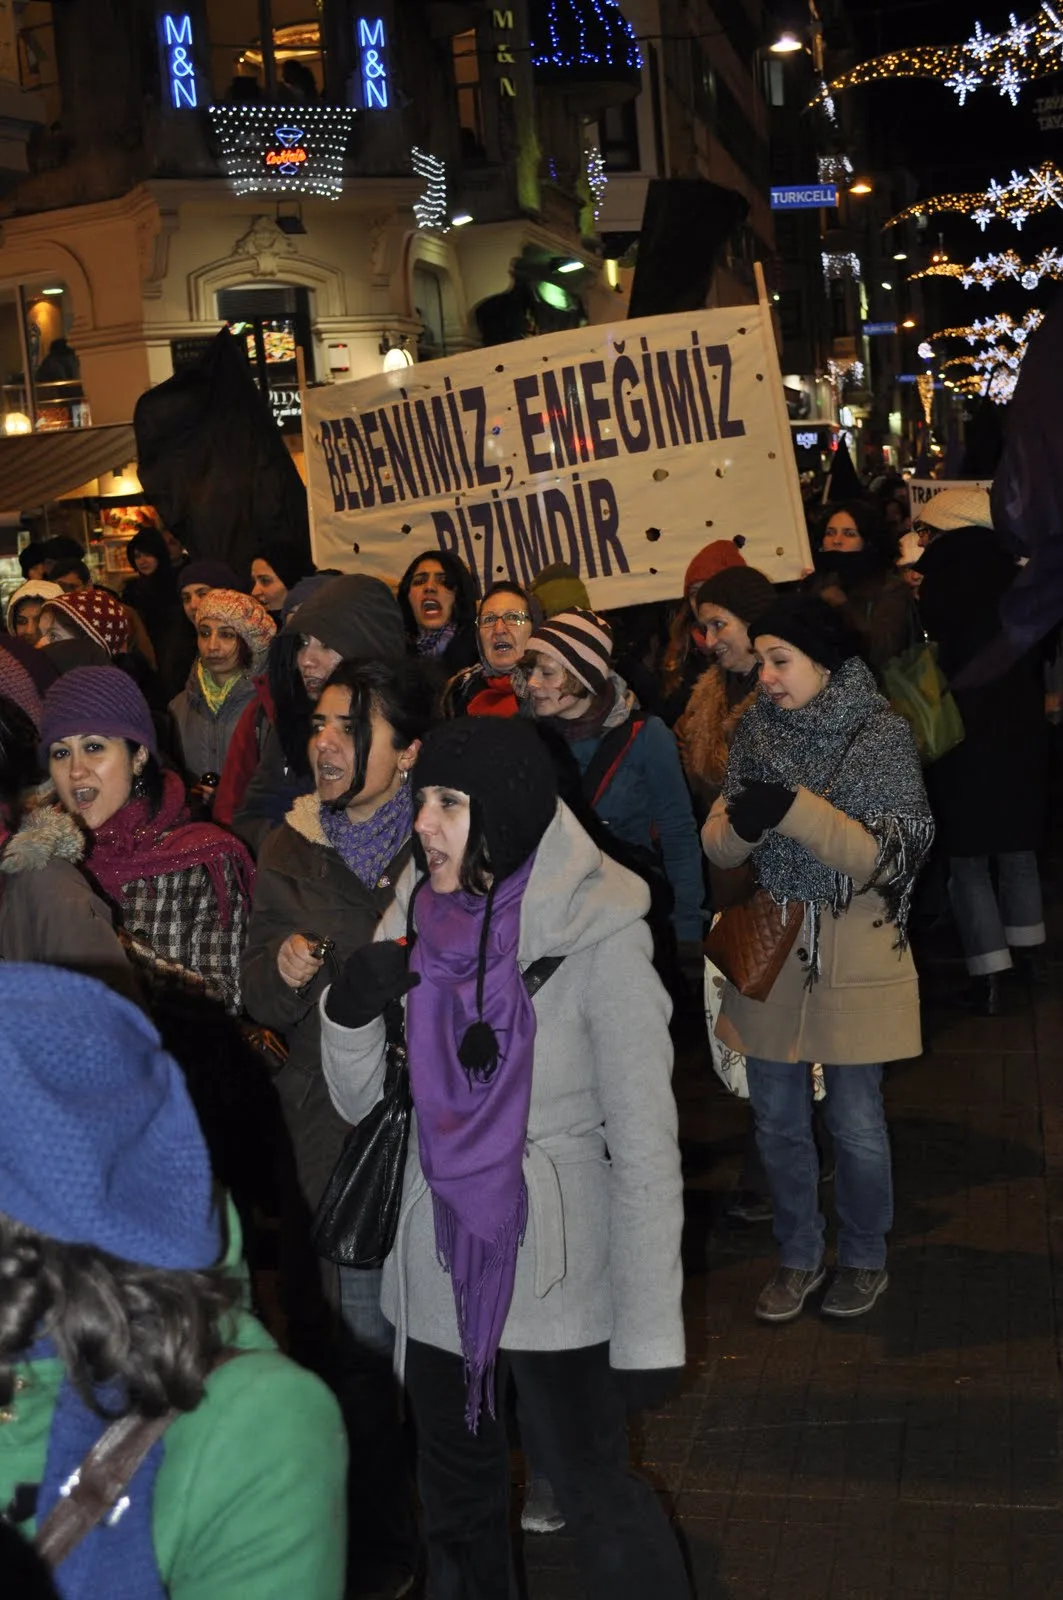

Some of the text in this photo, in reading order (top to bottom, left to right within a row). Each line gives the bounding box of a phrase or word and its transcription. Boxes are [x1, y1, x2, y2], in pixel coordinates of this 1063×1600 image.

[164, 15, 197, 108] M&N
[359, 18, 388, 108] M&N
[493, 10, 516, 97] M&N
[771, 190, 835, 204] TURKCELL
[320, 330, 746, 512] BEDENİMİZ, EMEĞİMİZ
